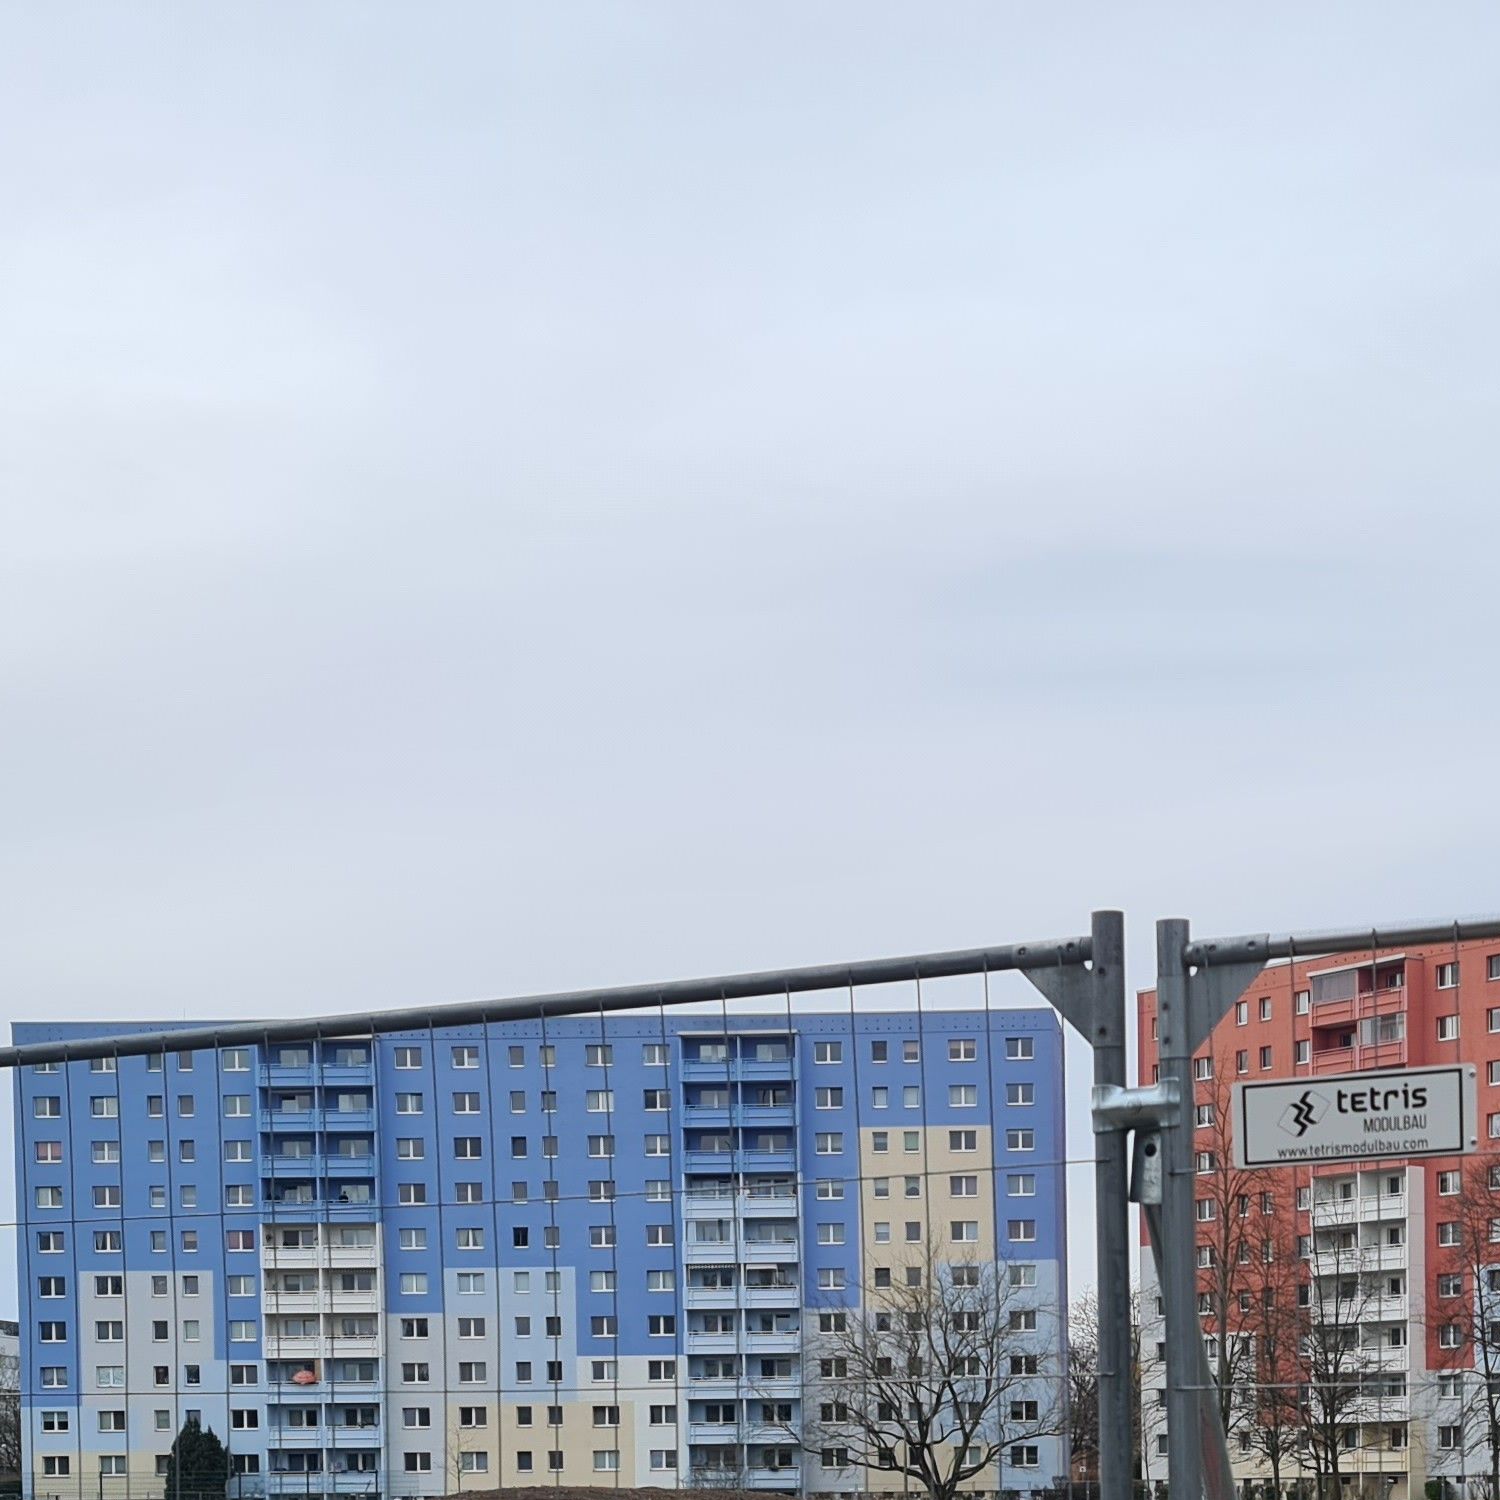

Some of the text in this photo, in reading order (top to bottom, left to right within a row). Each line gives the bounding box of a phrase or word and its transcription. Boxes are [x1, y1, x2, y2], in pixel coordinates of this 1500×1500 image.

[1337, 1083, 1428, 1113] tetris
[1363, 1114, 1427, 1133] MODULBAU
[1277, 1138, 1428, 1159] www.tetrismodulbau.com
